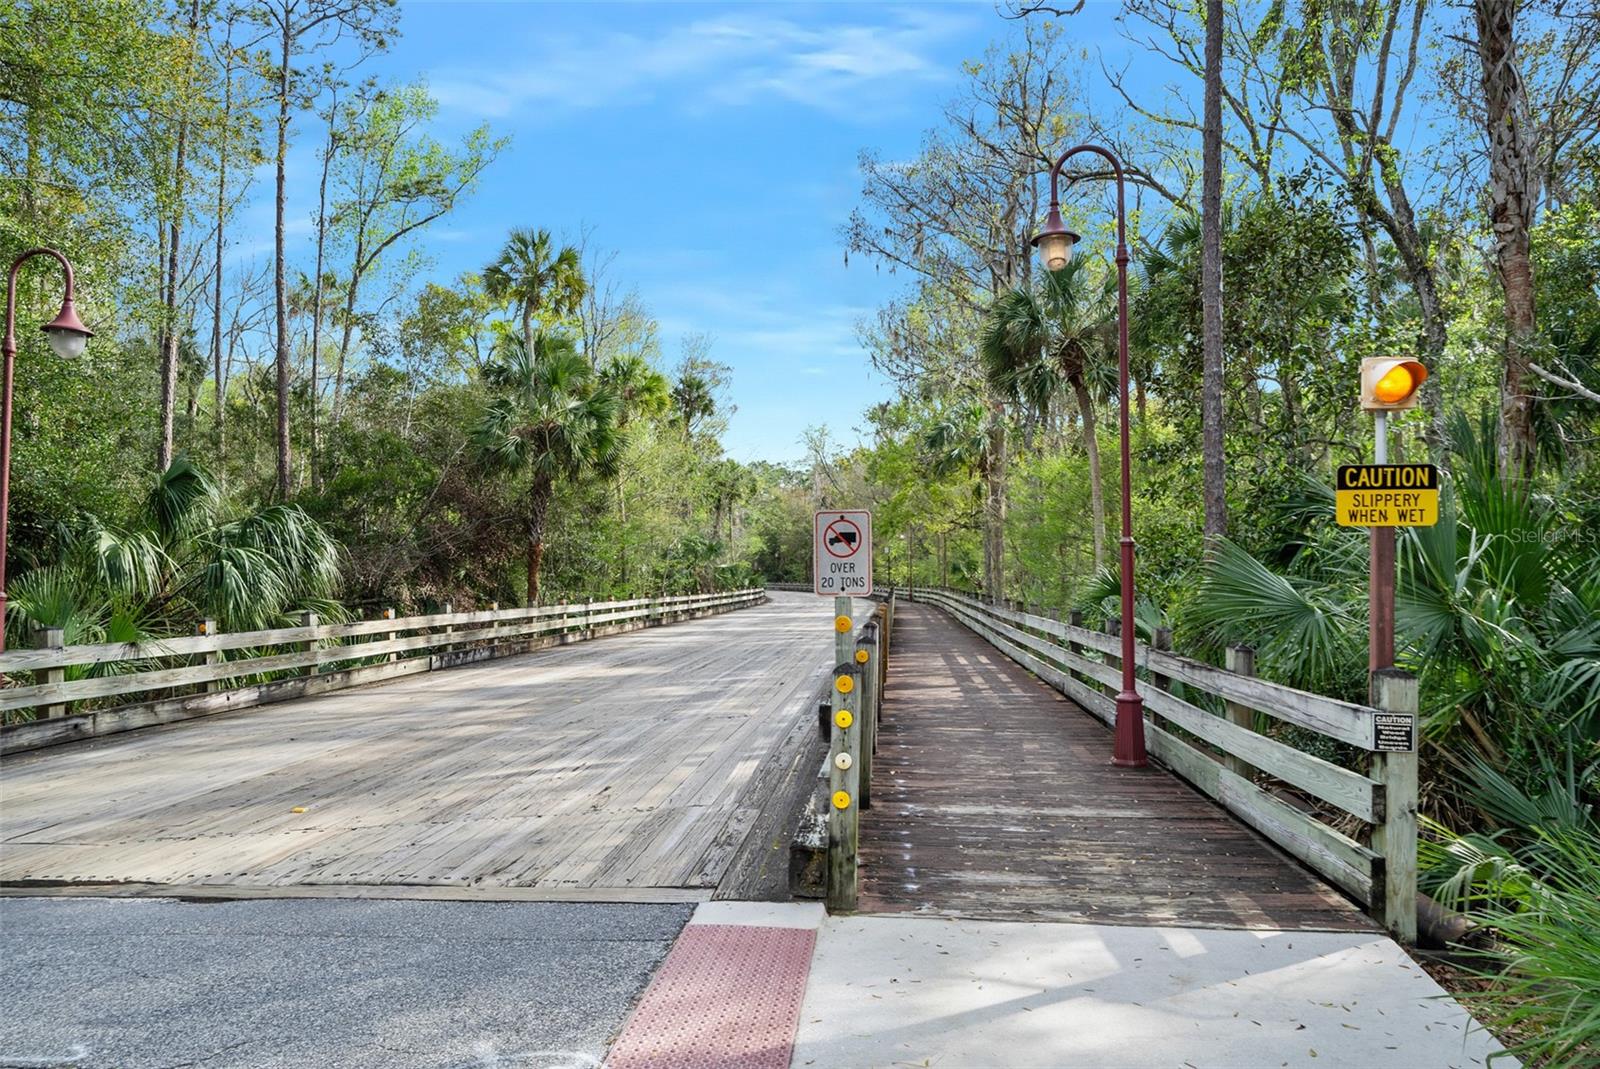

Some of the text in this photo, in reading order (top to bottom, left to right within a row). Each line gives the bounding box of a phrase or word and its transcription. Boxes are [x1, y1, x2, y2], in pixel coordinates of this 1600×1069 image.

[1345, 467, 1429, 487] CAUTION
[1352, 494, 1421, 507] SLIPPERY
[1348, 509, 1426, 522] WHEN WET
[830, 562, 856, 574] OVER
[821, 576, 865, 588] 20 TONS
[1375, 715, 1412, 724] CAUTION
